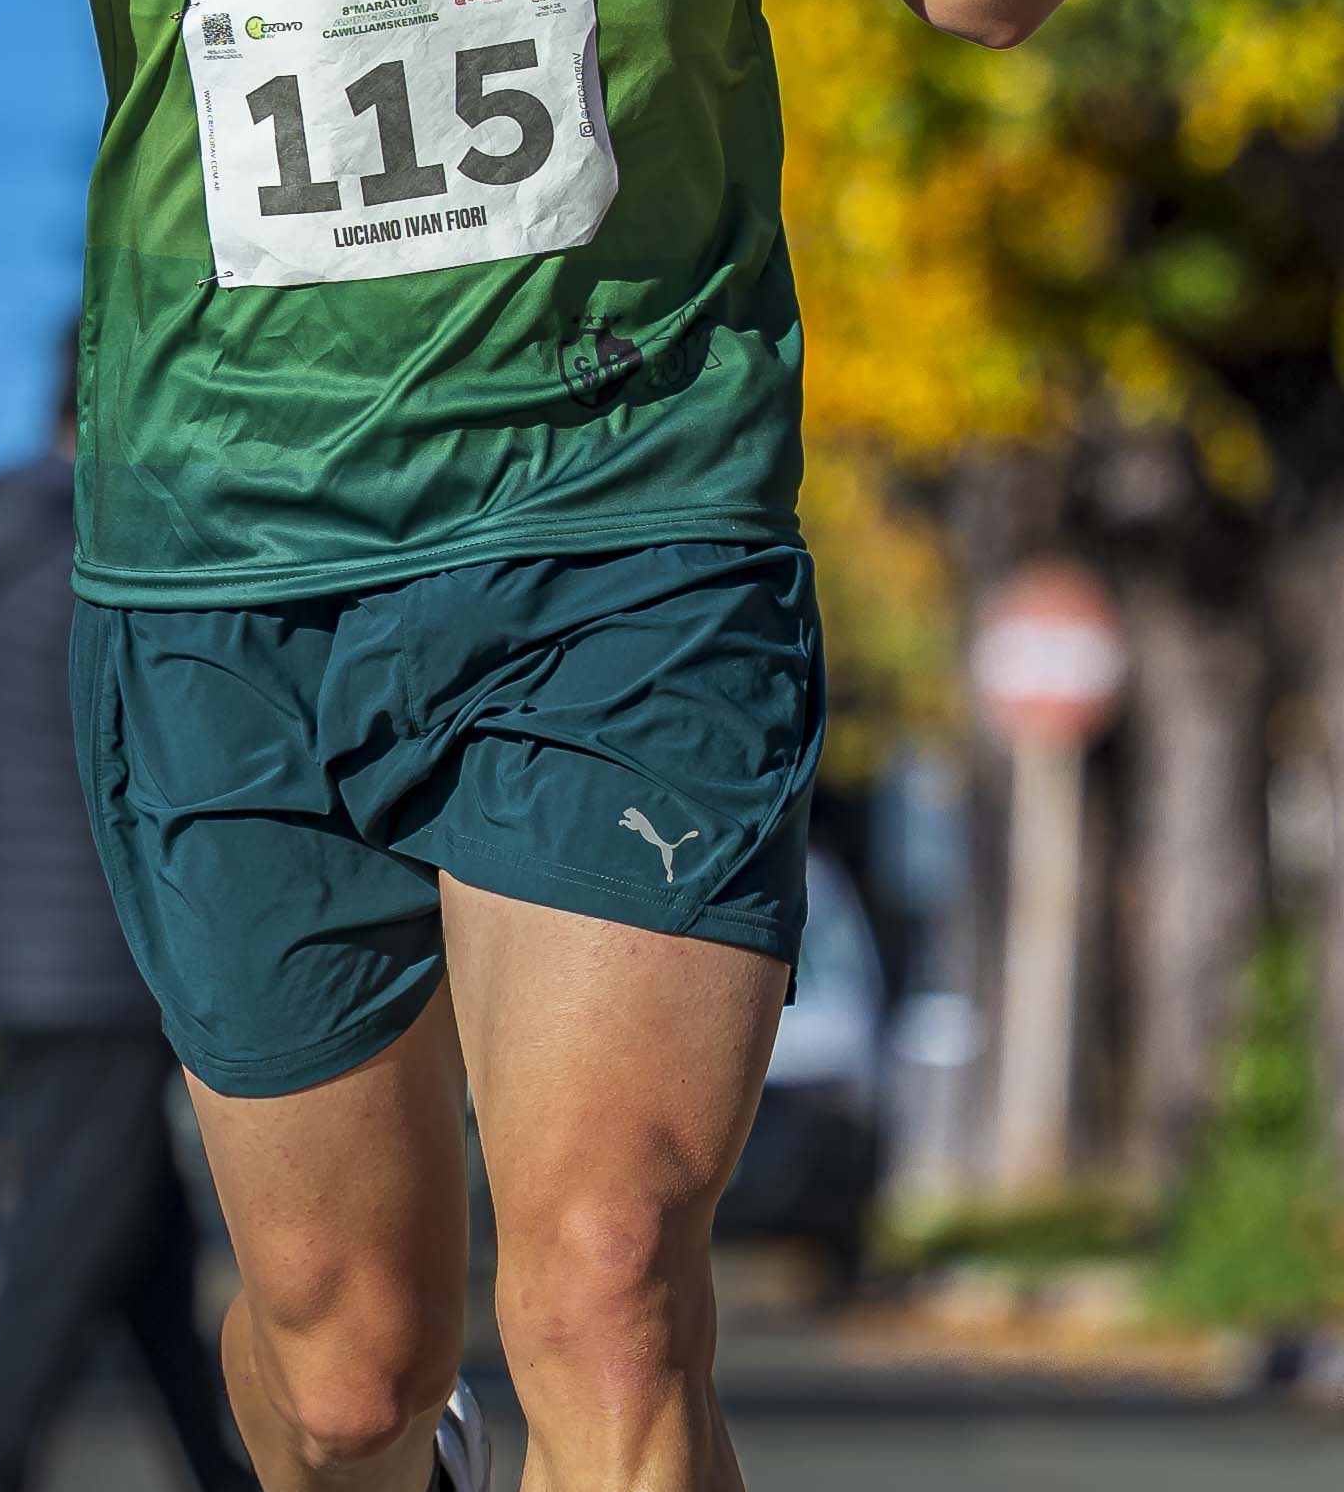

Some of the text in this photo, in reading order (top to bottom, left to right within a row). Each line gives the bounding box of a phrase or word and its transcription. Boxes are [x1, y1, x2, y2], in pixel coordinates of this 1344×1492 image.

[322, 13, 439, 39] CAWILLIAMSKEMMIS
[246, 39, 554, 216] 115
[333, 206, 488, 248] LUCIANO IVAN FIORI
